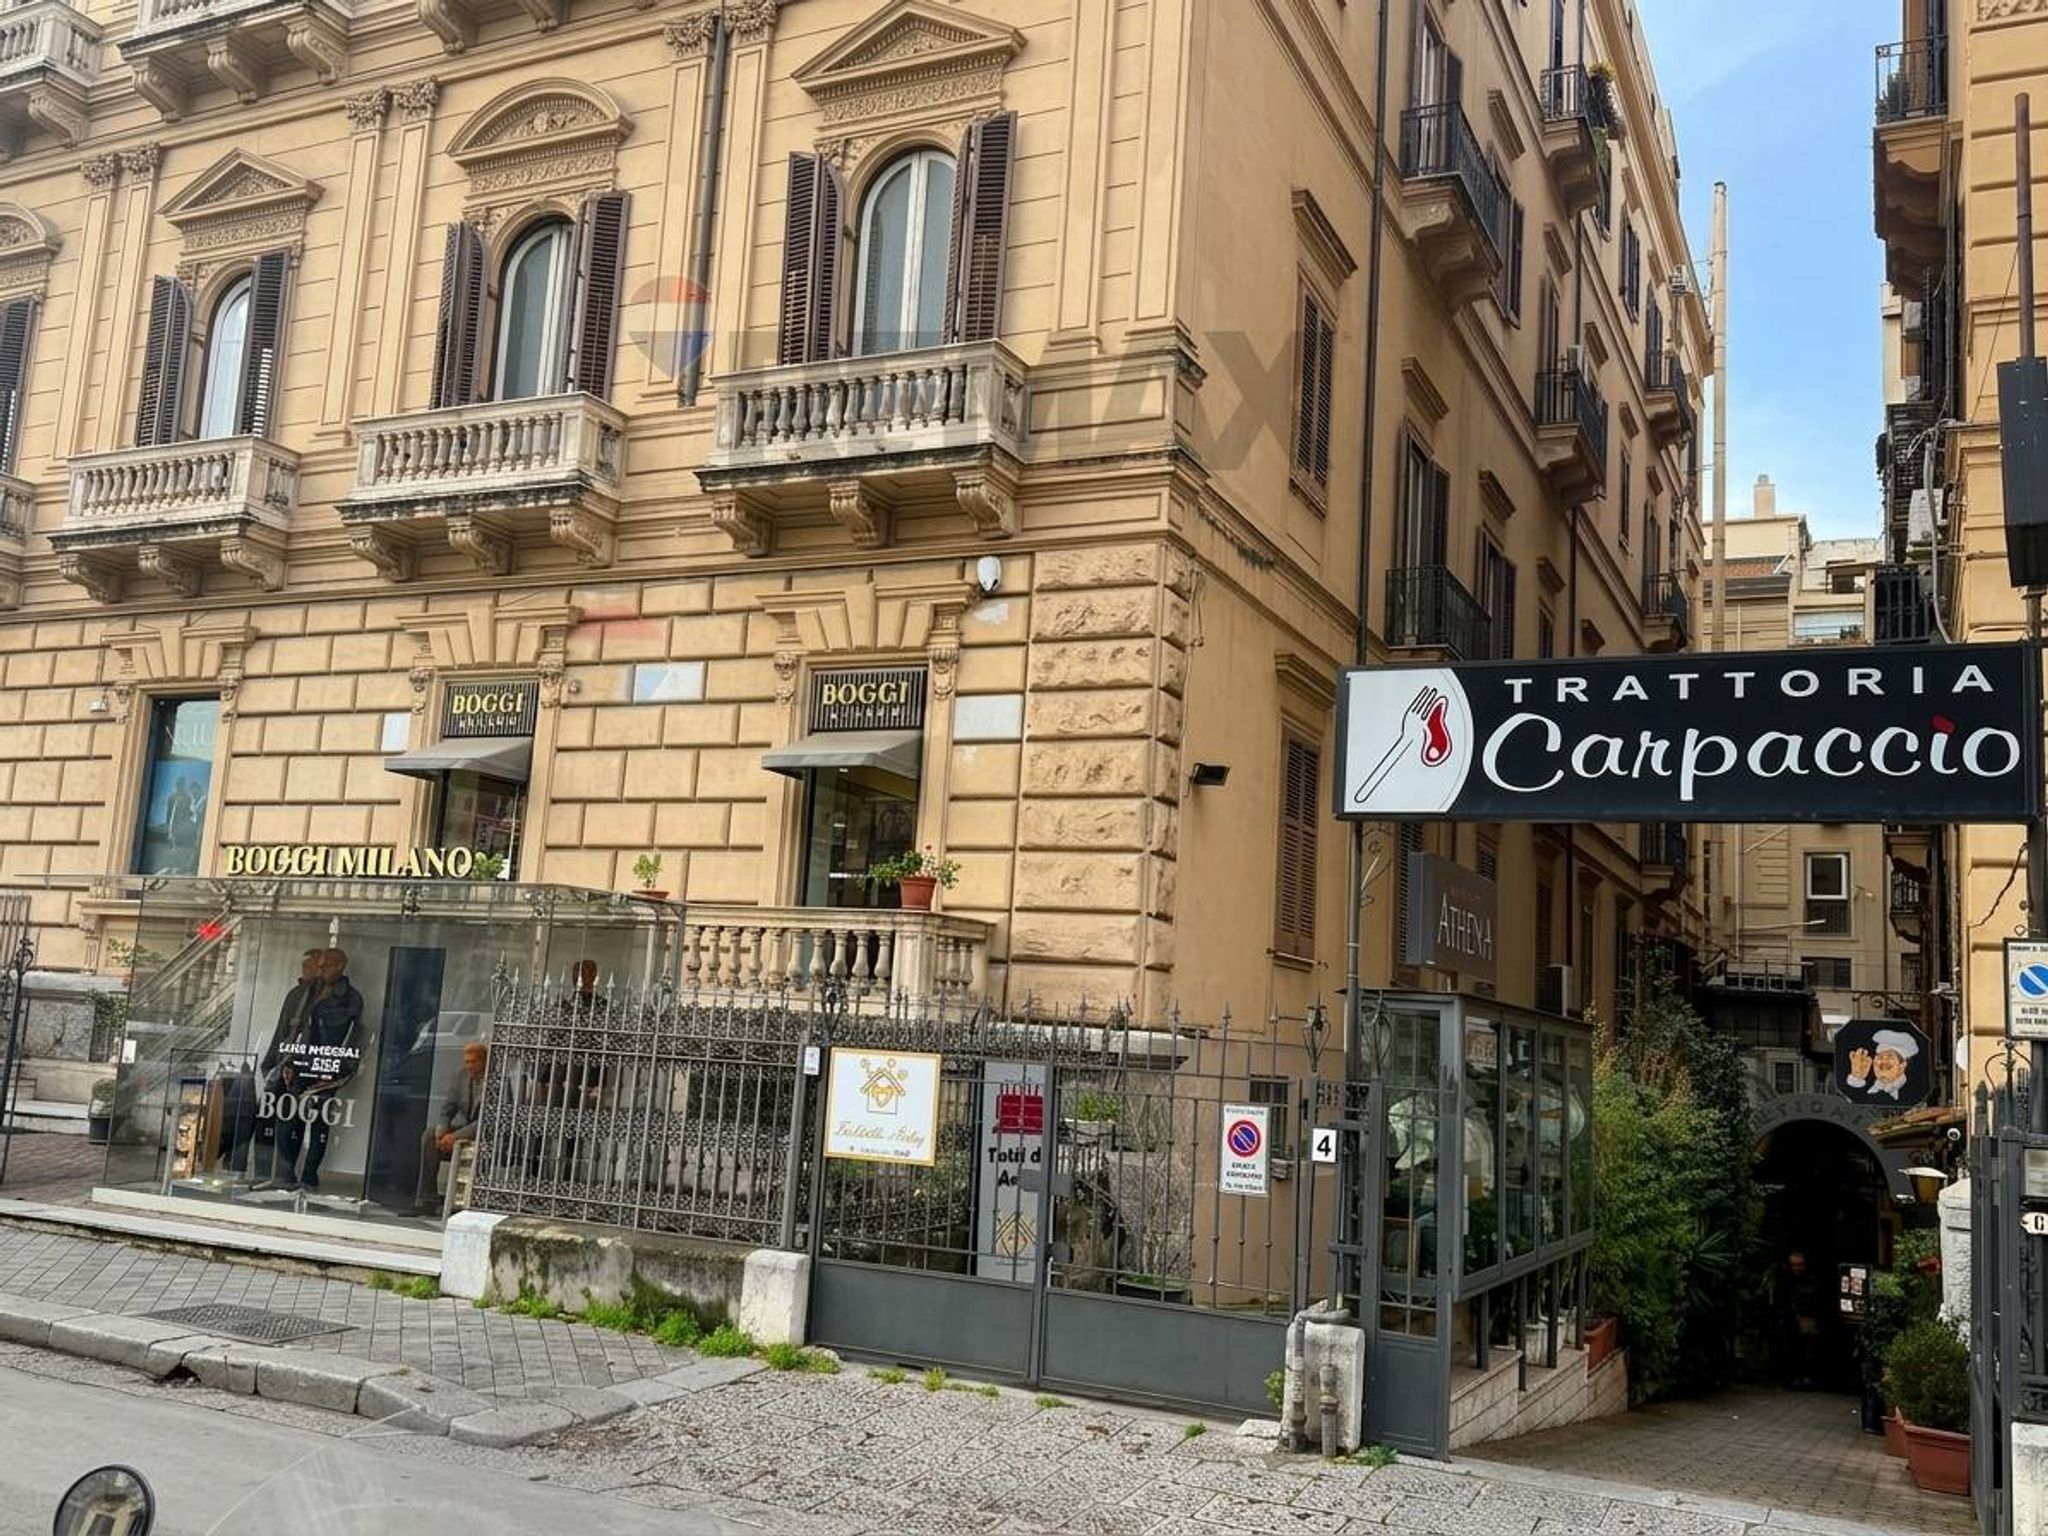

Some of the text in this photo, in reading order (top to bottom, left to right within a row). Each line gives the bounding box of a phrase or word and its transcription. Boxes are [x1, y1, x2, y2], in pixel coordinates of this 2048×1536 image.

[822, 681, 908, 705] BOGGI
[1503, 664, 1994, 703] TRATTORIA
[452, 692, 524, 714] BOGGI
[1482, 712, 2021, 801] Carpaccio
[227, 845, 473, 877] BOGGI MILANO
[256, 1091, 356, 1128] BOGGI
[1316, 1134, 1332, 1157] 4
